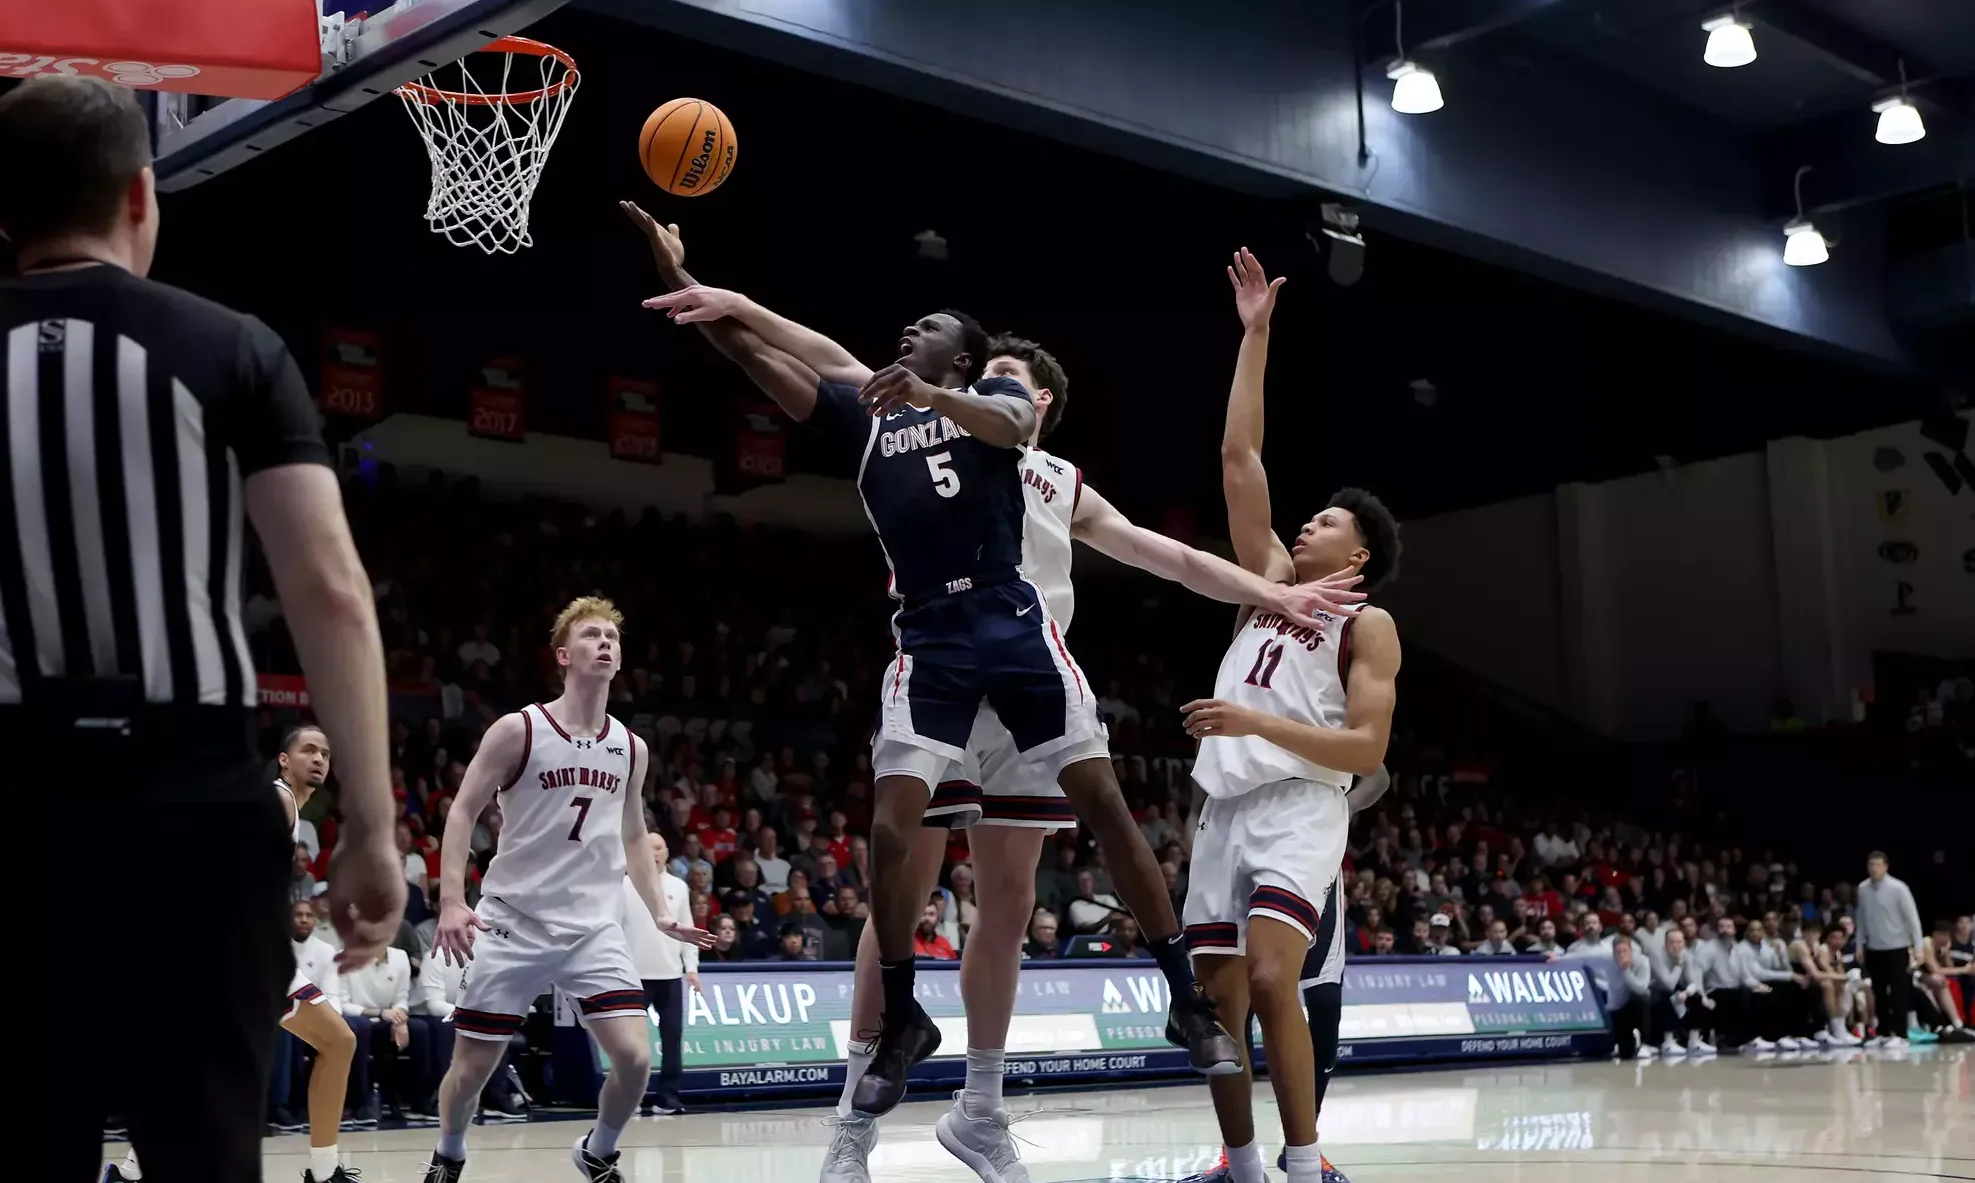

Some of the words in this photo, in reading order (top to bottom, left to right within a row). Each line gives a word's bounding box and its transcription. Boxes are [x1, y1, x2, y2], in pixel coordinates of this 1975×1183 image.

[679, 130, 716, 188] Wilson
[474, 407, 517, 433] 2017
[925, 451, 961, 498] 5
[1045, 459, 1064, 475] WCC
[1022, 468, 1057, 503] ARY'S
[945, 577, 973, 595] ZAGS
[1244, 638, 1284, 689] 11
[606, 746, 625, 755] WCC
[538, 767, 575, 790] SAINT
[579, 767, 621, 794] MARY'S
[567, 796, 593, 842] 7
[1036, 979, 1070, 996] LAW
[1484, 971, 1585, 1003] WALKUP
[713, 1038, 781, 1054] INJURY
[790, 1036, 827, 1051] LAW
[1461, 1039, 1495, 1053] DEFEND
[1496, 1037, 1519, 1050] YOUR
[1520, 1036, 1544, 1049] HOME
[1545, 1035, 1572, 1048] COURT
[1038, 1058, 1071, 1073] YOUR
[1073, 1056, 1107, 1071] HOME
[1108, 1054, 1147, 1069] COURT
[719, 1068, 829, 1087] BAYALARM.COM
